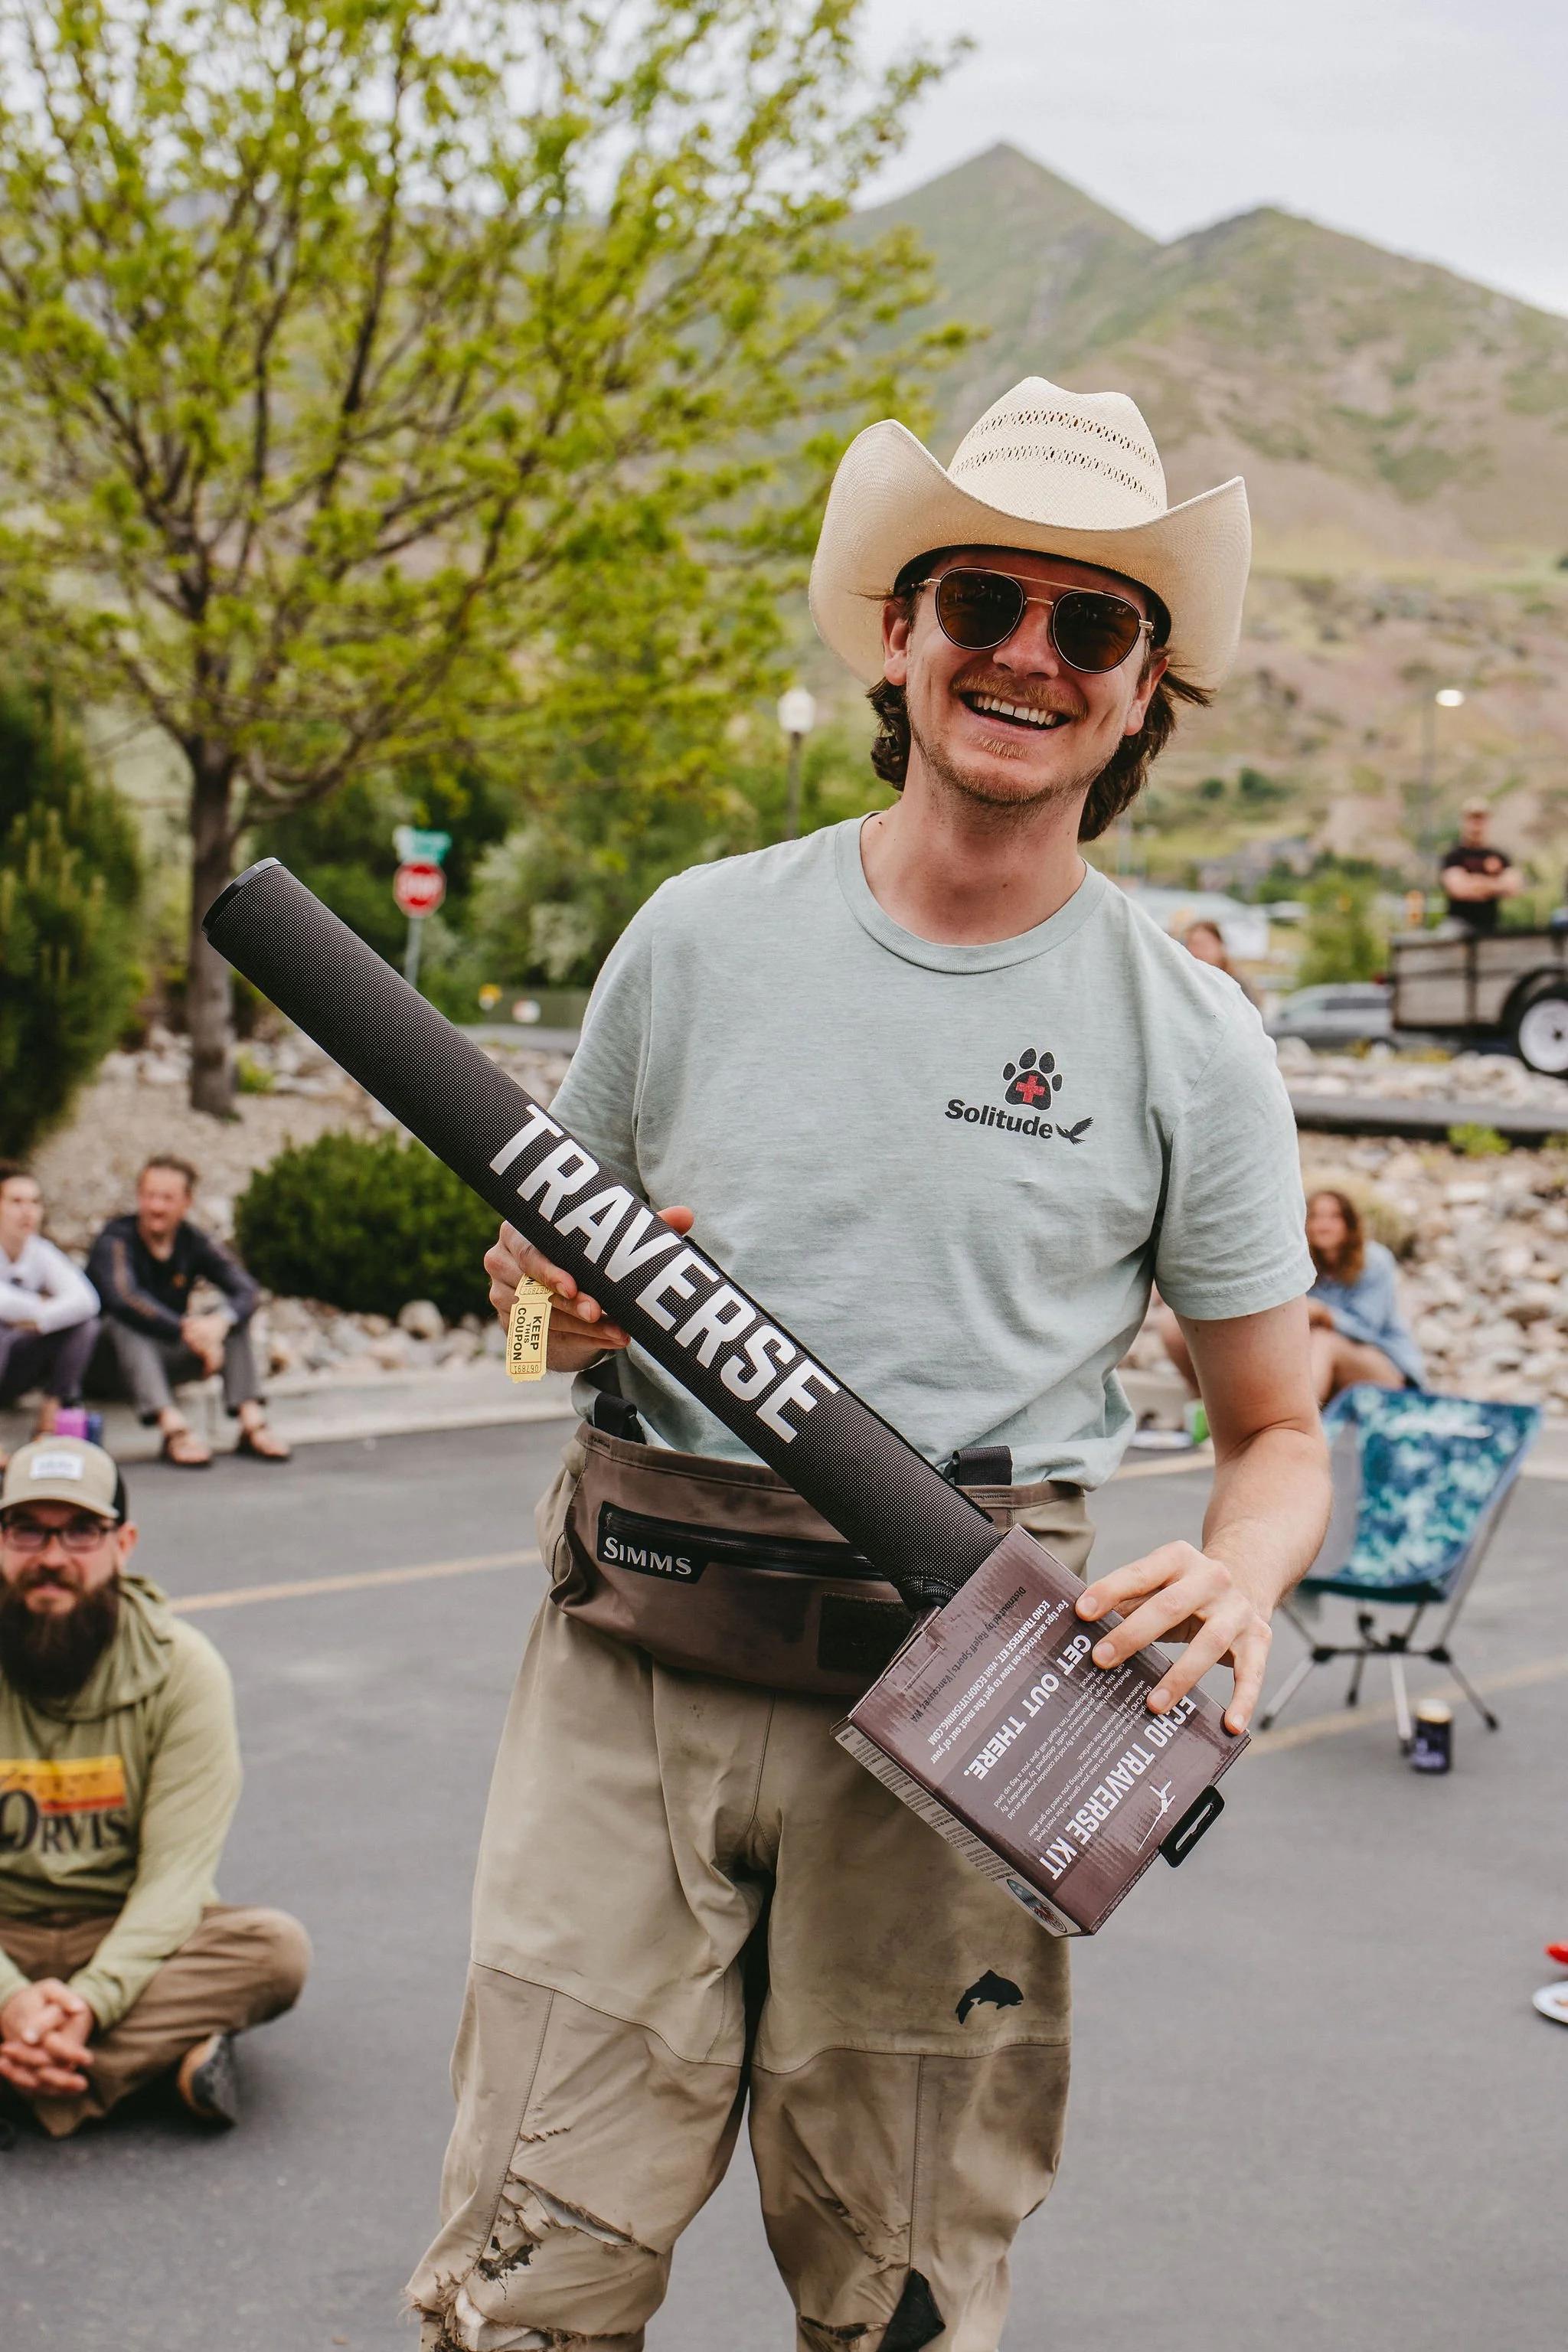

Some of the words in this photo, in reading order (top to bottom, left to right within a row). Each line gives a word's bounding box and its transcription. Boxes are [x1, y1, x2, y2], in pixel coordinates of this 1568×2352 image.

[945, 1099, 1053, 1139] Solitude
[489, 1103, 840, 1443] TRAVERSE
[513, 1308, 527, 1361] COUPON
[530, 1316, 542, 1351] KEEP
[603, 1537, 692, 1575] SIMMS
[992, 1586, 1027, 1625] Distributed
[1031, 1599, 1050, 1620] ECHO
[1055, 1599, 1069, 1614] For
[1044, 1609, 1060, 1626] tips
[984, 1621, 997, 1632] by
[1004, 1617, 1037, 1651] TRAVERSE
[1033, 1622, 1048, 1640] and
[968, 1630, 989, 1654] Rajeff
[1018, 1636, 1037, 1657] tricks
[950, 1648, 972, 1673] Sports
[994, 1647, 1010, 1664] KIT,
[1011, 1654, 1021, 1665] on
[1054, 1633, 1092, 1675] GET
[982, 1661, 998, 1677] visit
[998, 1663, 1016, 1681] how
[992, 1677, 1003, 1687] to
[1078, 1670, 1096, 1690] fence).
[1094, 1671, 1106, 1684] and
[1105, 1674, 1116, 1685] this
[1112, 1668, 1132, 1690] Whether
[918, 1674, 953, 1711] Vancouver,
[982, 1684, 995, 1700] get
[1021, 1672, 1060, 1717] OUT
[1086, 1681, 1096, 1694] rod
[1093, 1684, 1107, 1698] high
[1103, 1687, 1114, 1700] you
[1124, 1679, 1145, 1704] whatever
[1142, 1685, 1152, 1696] the
[926, 1674, 988, 1745] ECHOFLYFISHING.COM
[972, 1697, 987, 1712] the
[1093, 1698, 1107, 1713] have
[1116, 1702, 1127, 1713] lies
[1130, 1694, 1145, 1711] ECHO
[910, 1708, 923, 1723] WA
[958, 1709, 976, 1729] most
[1058, 1716, 1070, 1727] Tim
[1067, 1697, 1096, 1730] performance
[1082, 1710, 1096, 1726] never
[1113, 1709, 1133, 1731] Traverse
[1099, 1711, 1120, 1733] beneath
[1121, 1718, 1135, 1735] setup
[948, 1726, 962, 1741] out
[1046, 1725, 1061, 1743] Rajeff
[1055, 1730, 1069, 1746] outfit
[1073, 1725, 1084, 1737] cast
[1092, 1732, 1102, 1743] the
[1099, 1729, 1116, 1746] comes
[942, 1738, 952, 1750] of
[963, 1714, 1027, 1782] THERE.
[1038, 1740, 1049, 1753] will
[1065, 1738, 1074, 1747] fly
[1076, 1740, 1095, 1761] surface.
[1102, 1733, 1124, 1759] designed
[929, 1744, 946, 1764] your
[1028, 1749, 1040, 1763] give
[1034, 1745, 1056, 1771] designed
[1053, 1754, 1060, 1762] or
[1057, 1745, 1068, 1757] rod
[1090, 1746, 1102, 1759] with
[1020, 1760, 1031, 1773] you
[1027, 1769, 1037, 1779] by
[1036, 1760, 1055, 1783] consider
[1067, 1757, 1093, 1785] everything
[1089, 1762, 1100, 1775] take
[1008, 1775, 1020, 1787] leg
[1079, 1772, 1090, 1787] your
[1003, 1785, 1011, 1795] up
[1006, 1777, 1031, 1805] legendary
[1019, 1780, 1038, 1805] yourself
[1060, 1782, 1071, 1795] you
[1065, 1742, 1155, 1844] TRAVERSE
[1067, 1784, 1081, 1802] game
[992, 1792, 1006, 1808] (and
[1014, 1801, 1021, 1810] an
[1050, 1794, 1063, 1810] need
[1062, 1800, 1070, 1808] to
[999, 1804, 1008, 1813] fly
[1007, 1808, 1016, 1820] old
[1044, 1807, 1053, 1815] to
[1054, 1806, 1065, 1818] the
[1037, 1812, 1047, 1824] get
[1045, 1815, 1057, 1829] next
[1027, 1822, 1040, 1837] after
[1033, 1827, 1048, 1843] level,
[1037, 1836, 1077, 1880] KIT
